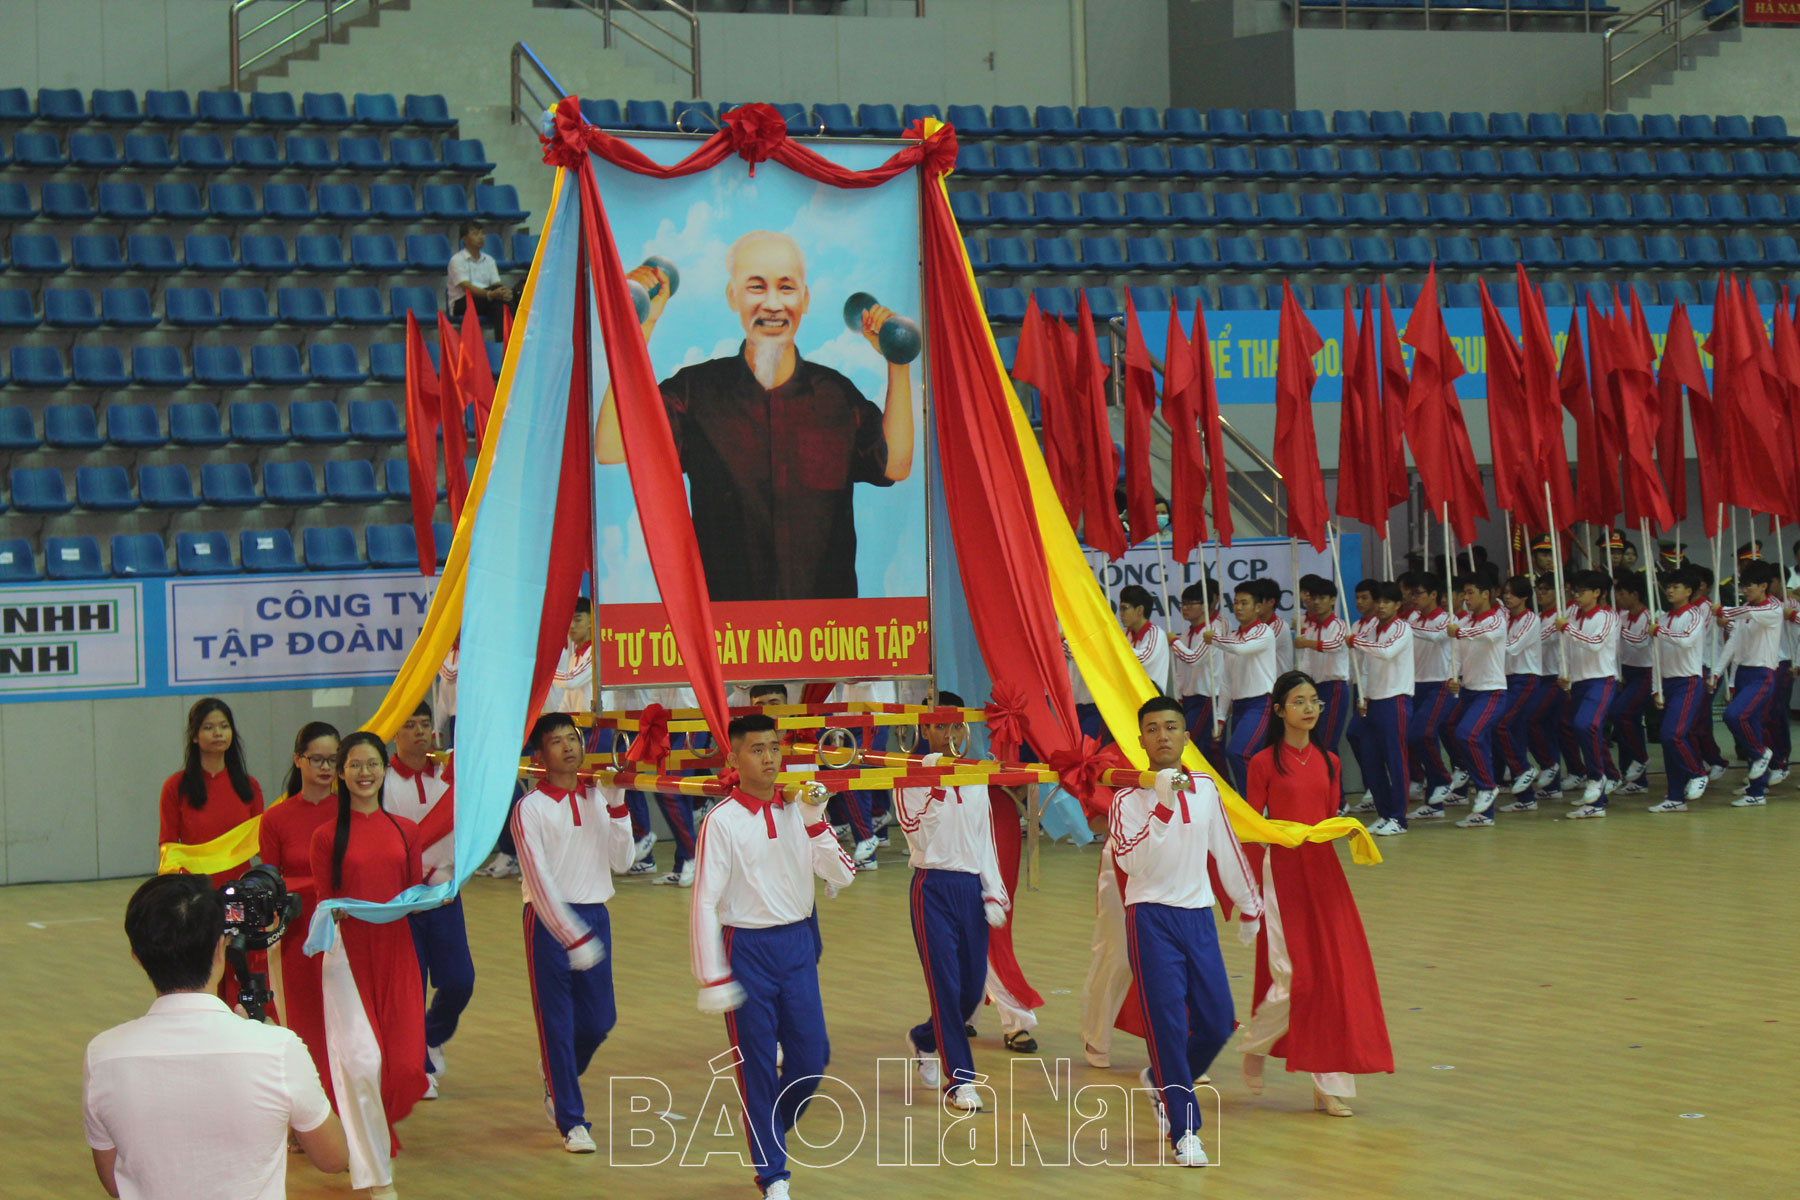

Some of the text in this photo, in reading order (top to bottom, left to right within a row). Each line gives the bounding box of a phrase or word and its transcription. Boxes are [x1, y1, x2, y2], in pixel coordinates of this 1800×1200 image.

[1778, 2, 1800, 15] NA
[1227, 559, 1268, 581] CP
[3, 604, 110, 634] NHH
[256, 589, 433, 620] CÔNG TY
[193, 623, 403, 666] TẬP ĐOÀN
[649, 624, 684, 667] TÔ
[757, 621, 803, 663] NÀO
[809, 620, 869, 662] CŨNG
